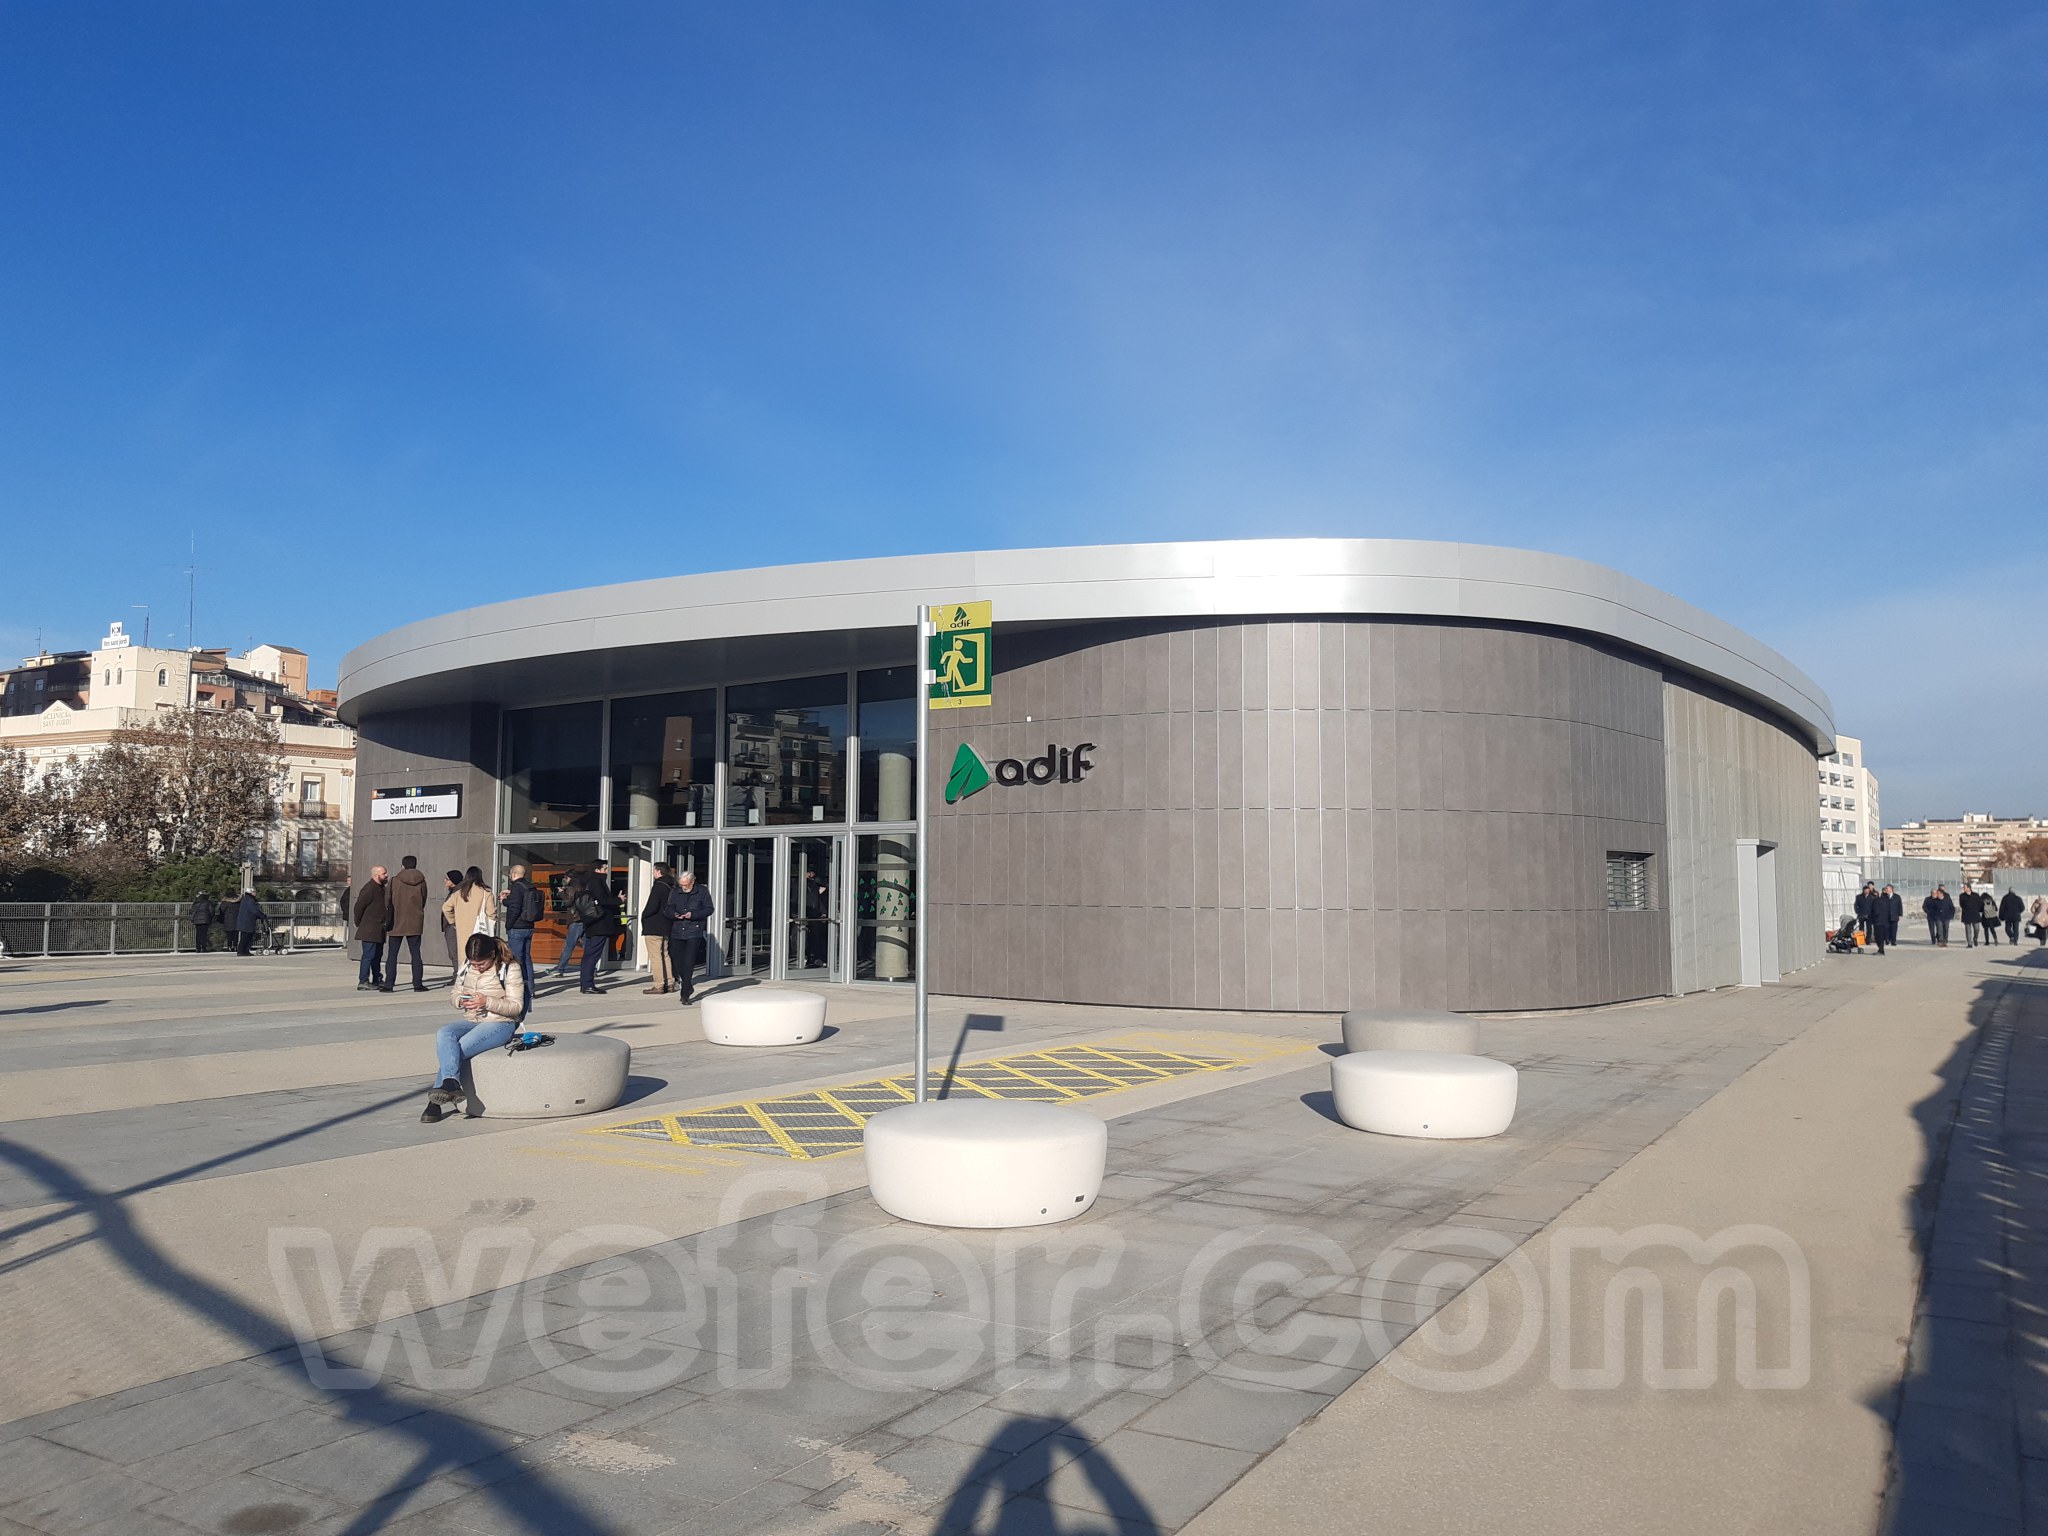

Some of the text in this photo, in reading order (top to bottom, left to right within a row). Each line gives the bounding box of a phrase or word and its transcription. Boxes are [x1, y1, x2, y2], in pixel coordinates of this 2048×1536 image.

[949, 618, 971, 628] adif
[995, 742, 1096, 787] adif
[389, 801, 438, 815] Sant Andreu
